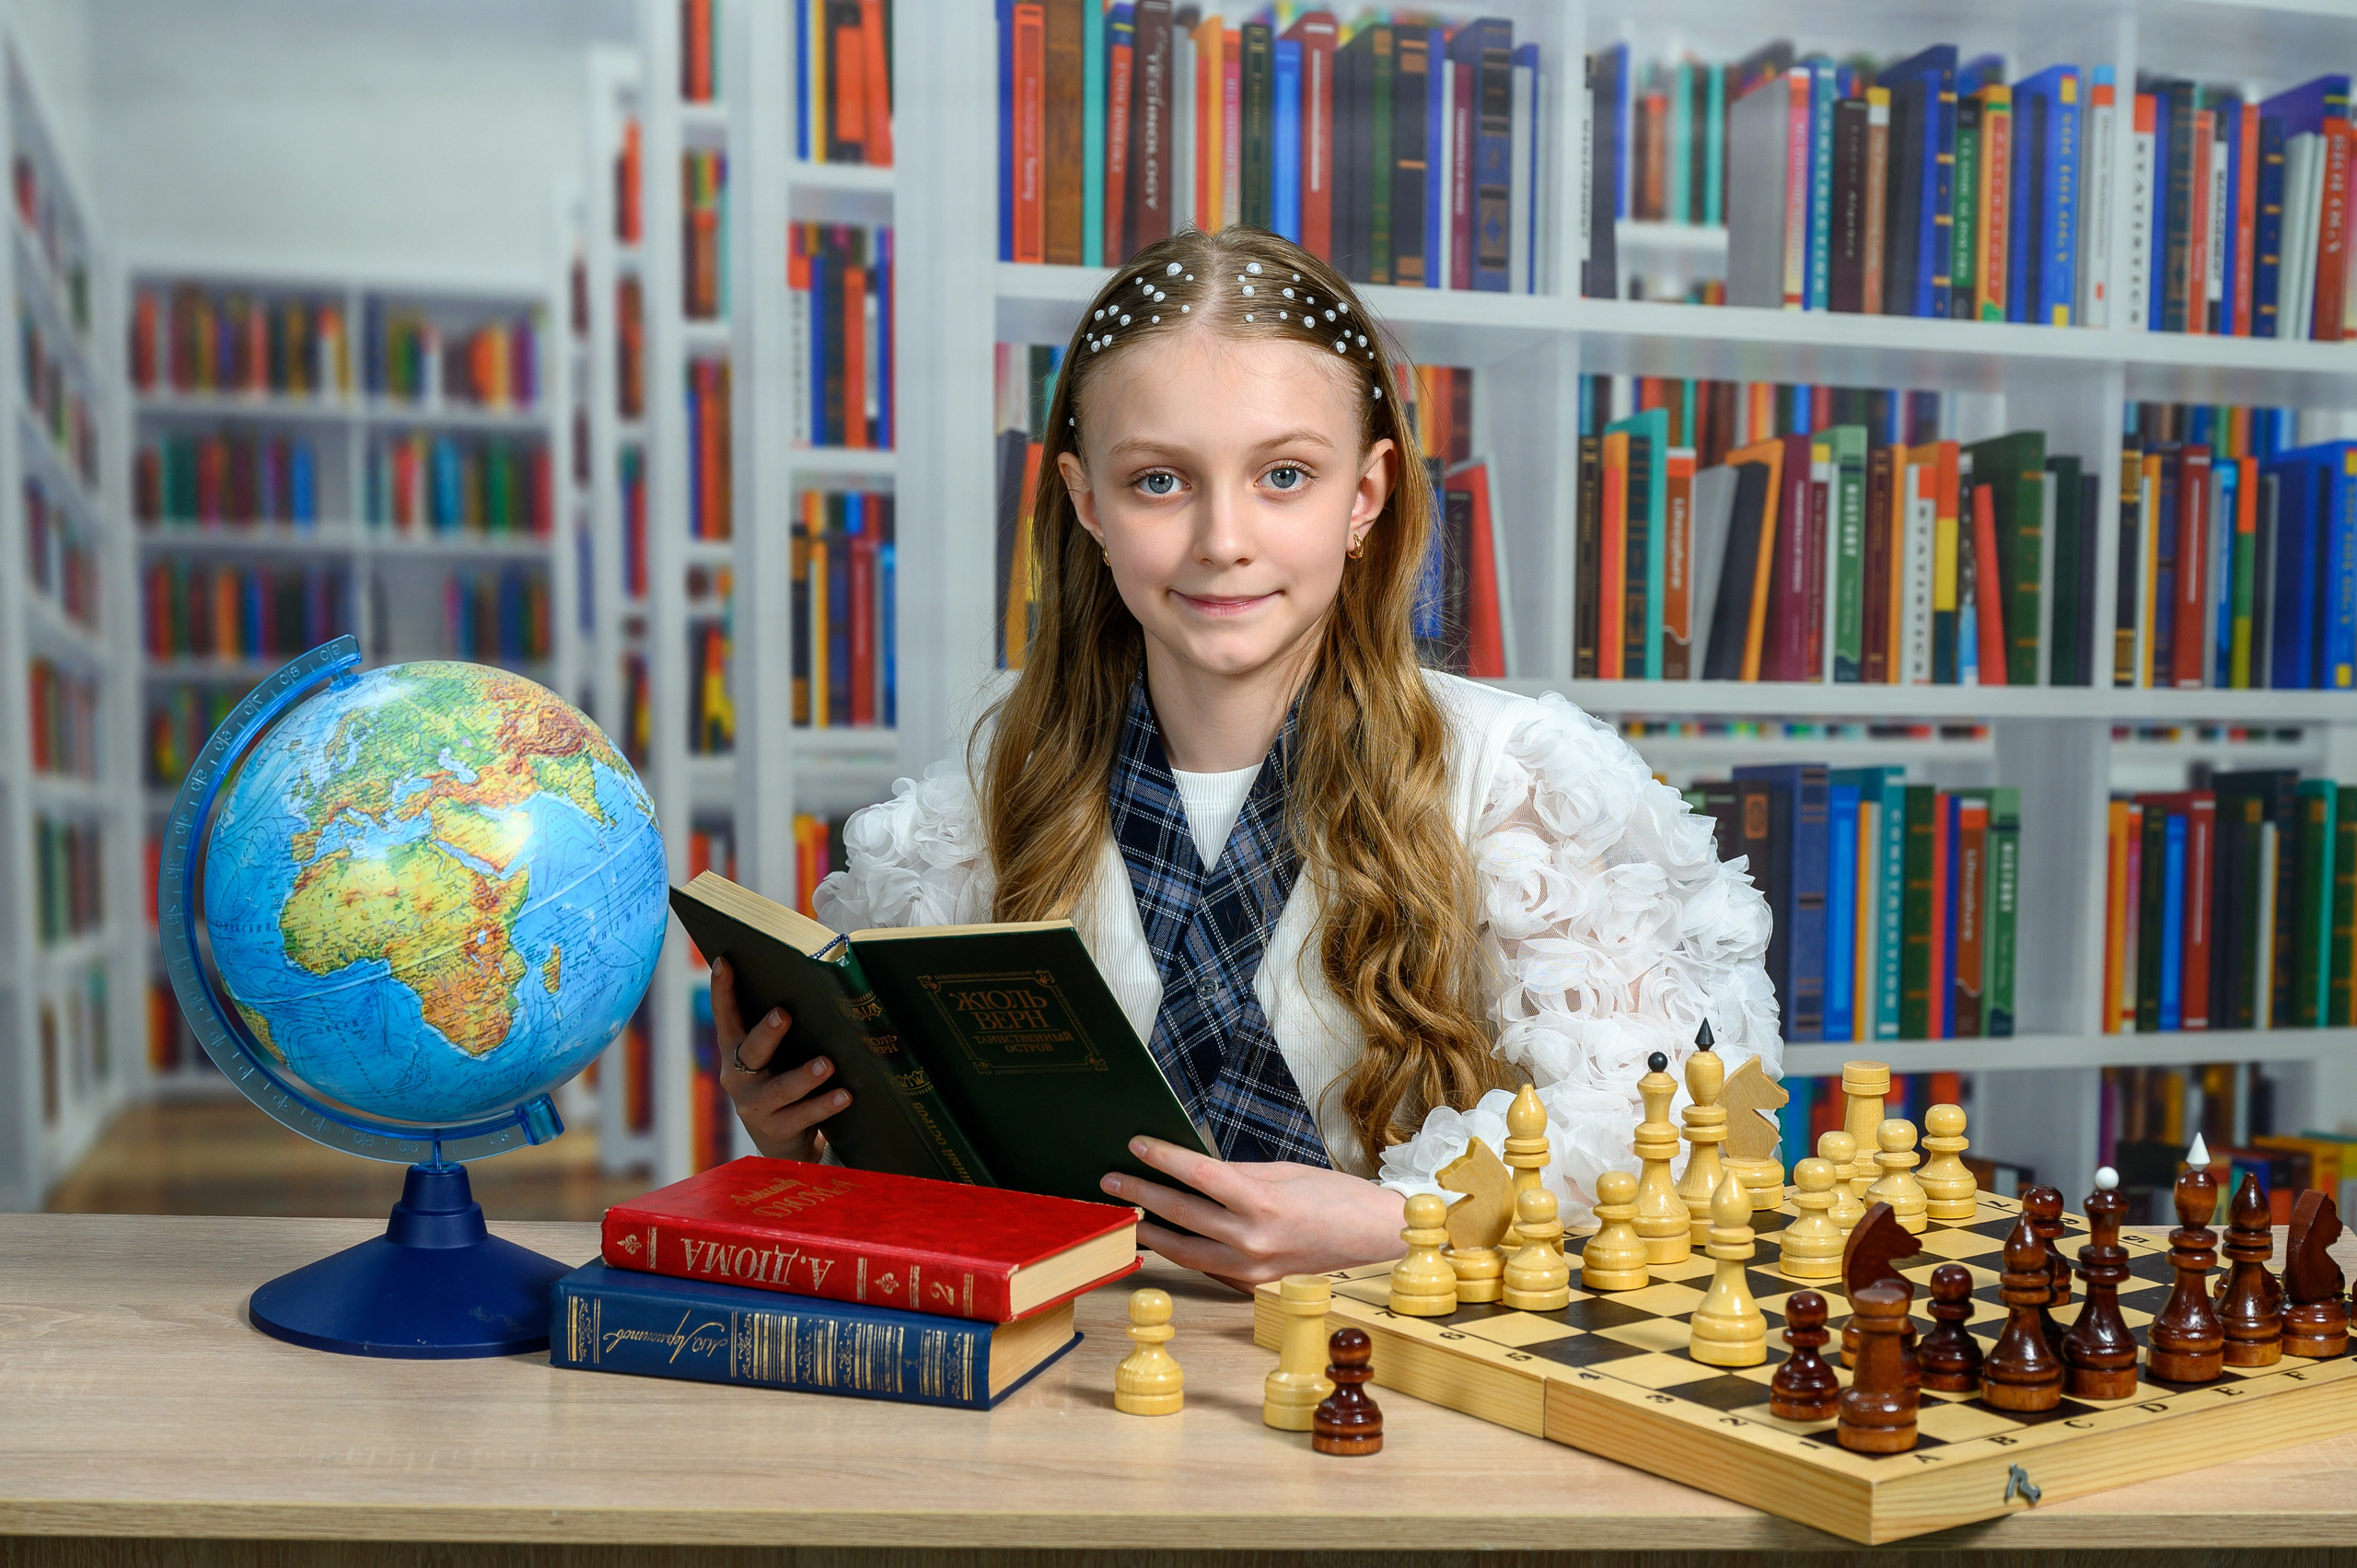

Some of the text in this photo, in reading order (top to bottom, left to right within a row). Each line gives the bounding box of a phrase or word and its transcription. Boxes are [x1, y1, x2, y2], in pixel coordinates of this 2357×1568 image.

[948, 990, 1048, 1011] ЖЮЛЬ
[971, 1009, 1051, 1030] ВЕРН
[972, 1030, 1074, 1045] ТАИНСТВЕННЫЙ
[1004, 1042, 1054, 1053] ОСТРОВ
[912, 1101, 947, 1145] ОСТРОВ
[929, 1281, 956, 1307] 2
